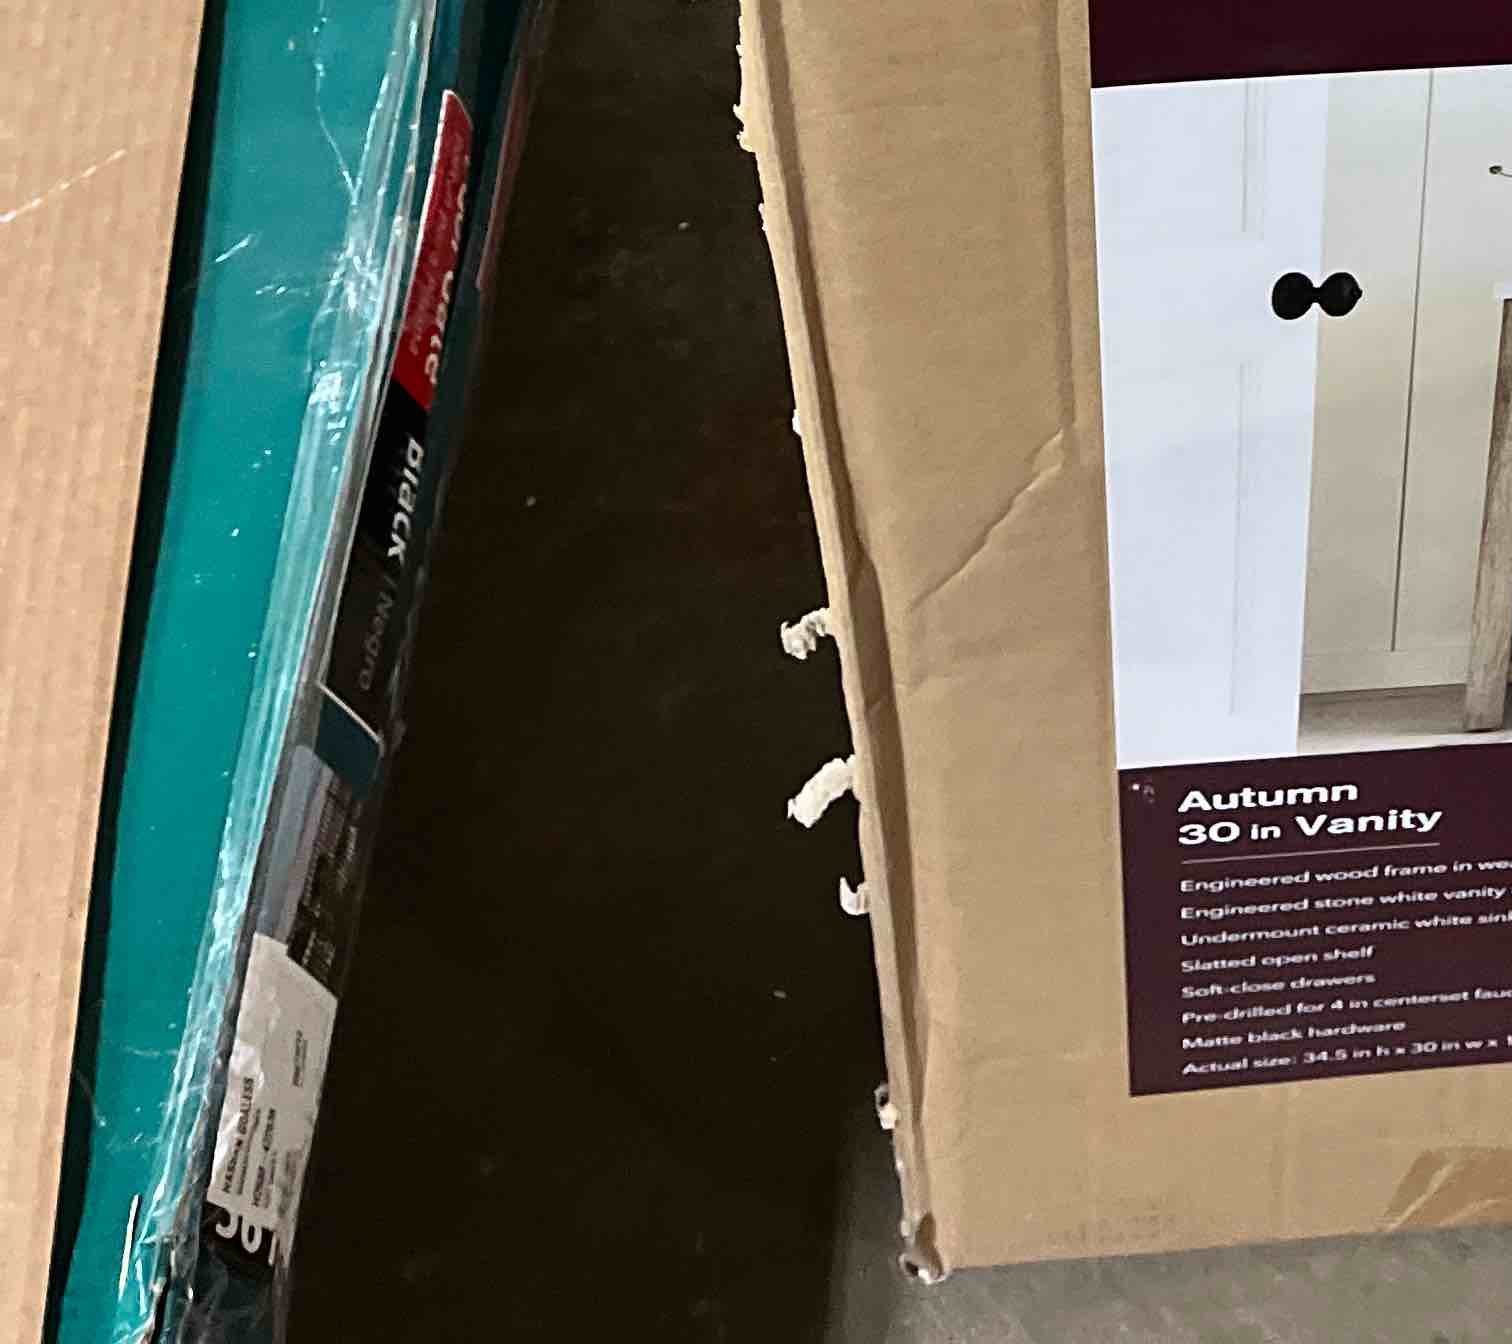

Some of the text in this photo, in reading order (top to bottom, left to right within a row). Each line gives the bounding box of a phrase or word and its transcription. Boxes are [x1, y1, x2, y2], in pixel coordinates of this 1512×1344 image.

[358, 593, 395, 693] Negro
[1178, 782, 1359, 813] Autumn
[1178, 808, 1442, 846] 30 in Vanity
[1180, 870, 1310, 892] Engineered
[1315, 865, 1378, 882] wood
[1384, 863, 1448, 878] frame
[1452, 860, 1473, 872] in
[1180, 898, 1309, 920] Engineered
[1314, 895, 1374, 910] stone
[1380, 890, 1438, 904] white
[1443, 885, 1506, 900] vanity
[1180, 925, 1320, 946] Undermount
[1325, 919, 1410, 935] ceramic
[1415, 915, 1473, 929] white
[1181, 946, 1375, 973] Slatted open shelf
[1290, 973, 1376, 989] drawers
[1296, 1002, 1326, 1014] for
[1330, 1000, 1344, 1010] 4
[1373, 991, 1470, 1009] centerset
[1182, 1021, 1406, 1050] Matte black hardware
[1182, 1057, 1248, 1075] Actual
[1303, 1049, 1348, 1064] 34.5
[1352, 1048, 1372, 1059] in
[1376, 1045, 1391, 1057] h
[1410, 1041, 1439, 1055] 30
[1441, 1039, 1460, 1052] in
[1464, 1039, 1484, 1050] w
